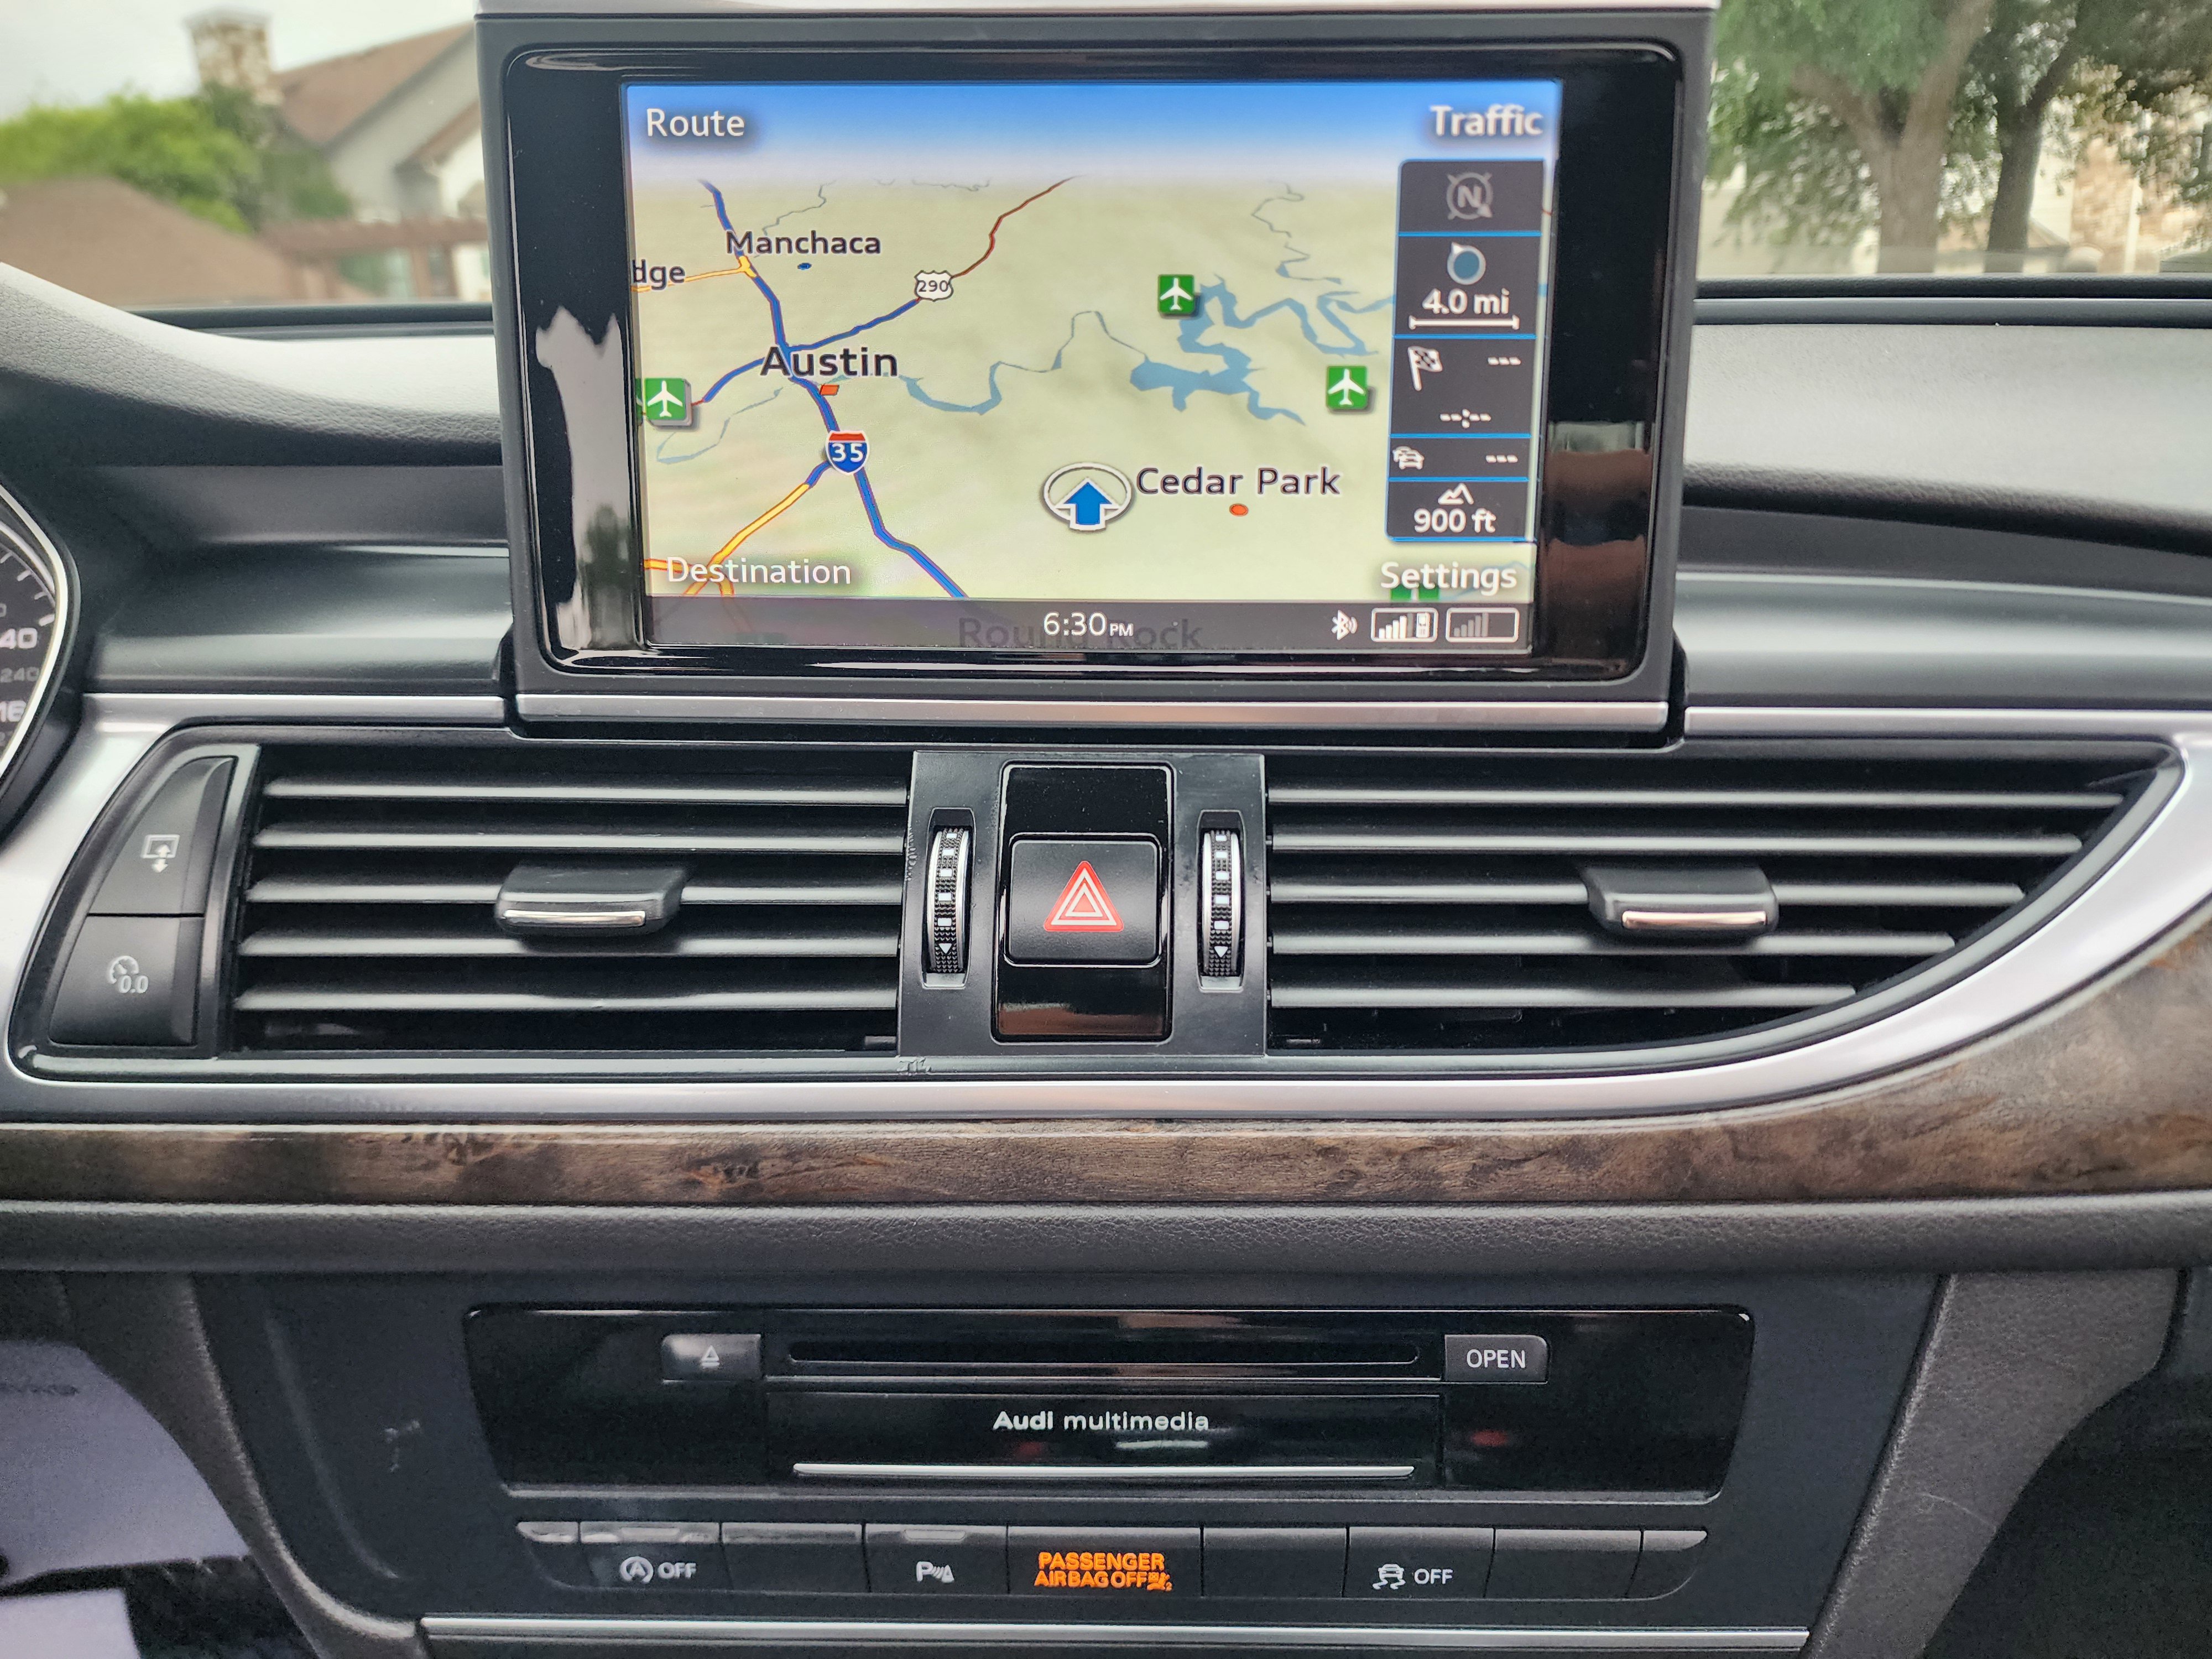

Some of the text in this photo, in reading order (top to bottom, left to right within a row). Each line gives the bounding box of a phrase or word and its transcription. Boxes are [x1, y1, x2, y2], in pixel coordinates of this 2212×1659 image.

[646, 108, 745, 138] Route
[1429, 103, 1544, 137] Traffic
[727, 231, 881, 255] Manchaca
[916, 279, 951, 293] 290
[1422, 288, 1510, 314] 4.0 mi
[760, 346, 899, 377] Austin
[832, 442, 865, 463] 35
[1136, 466, 1340, 495] Cedar Park
[1413, 508, 1497, 533] 900 ft
[667, 556, 852, 585] Destination
[1380, 561, 1517, 595] Settings
[1044, 612, 1134, 637] 6:30 PM
[1466, 1349, 1526, 1369] OPEN
[993, 1410, 1210, 1432] Audi multimedia
[658, 1562, 697, 1579] OFF
[1038, 1551, 1165, 1571] PASSENGER
[1033, 1570, 1147, 1588] AIRBAG OFF
[1413, 1568, 1454, 1584] OFF
